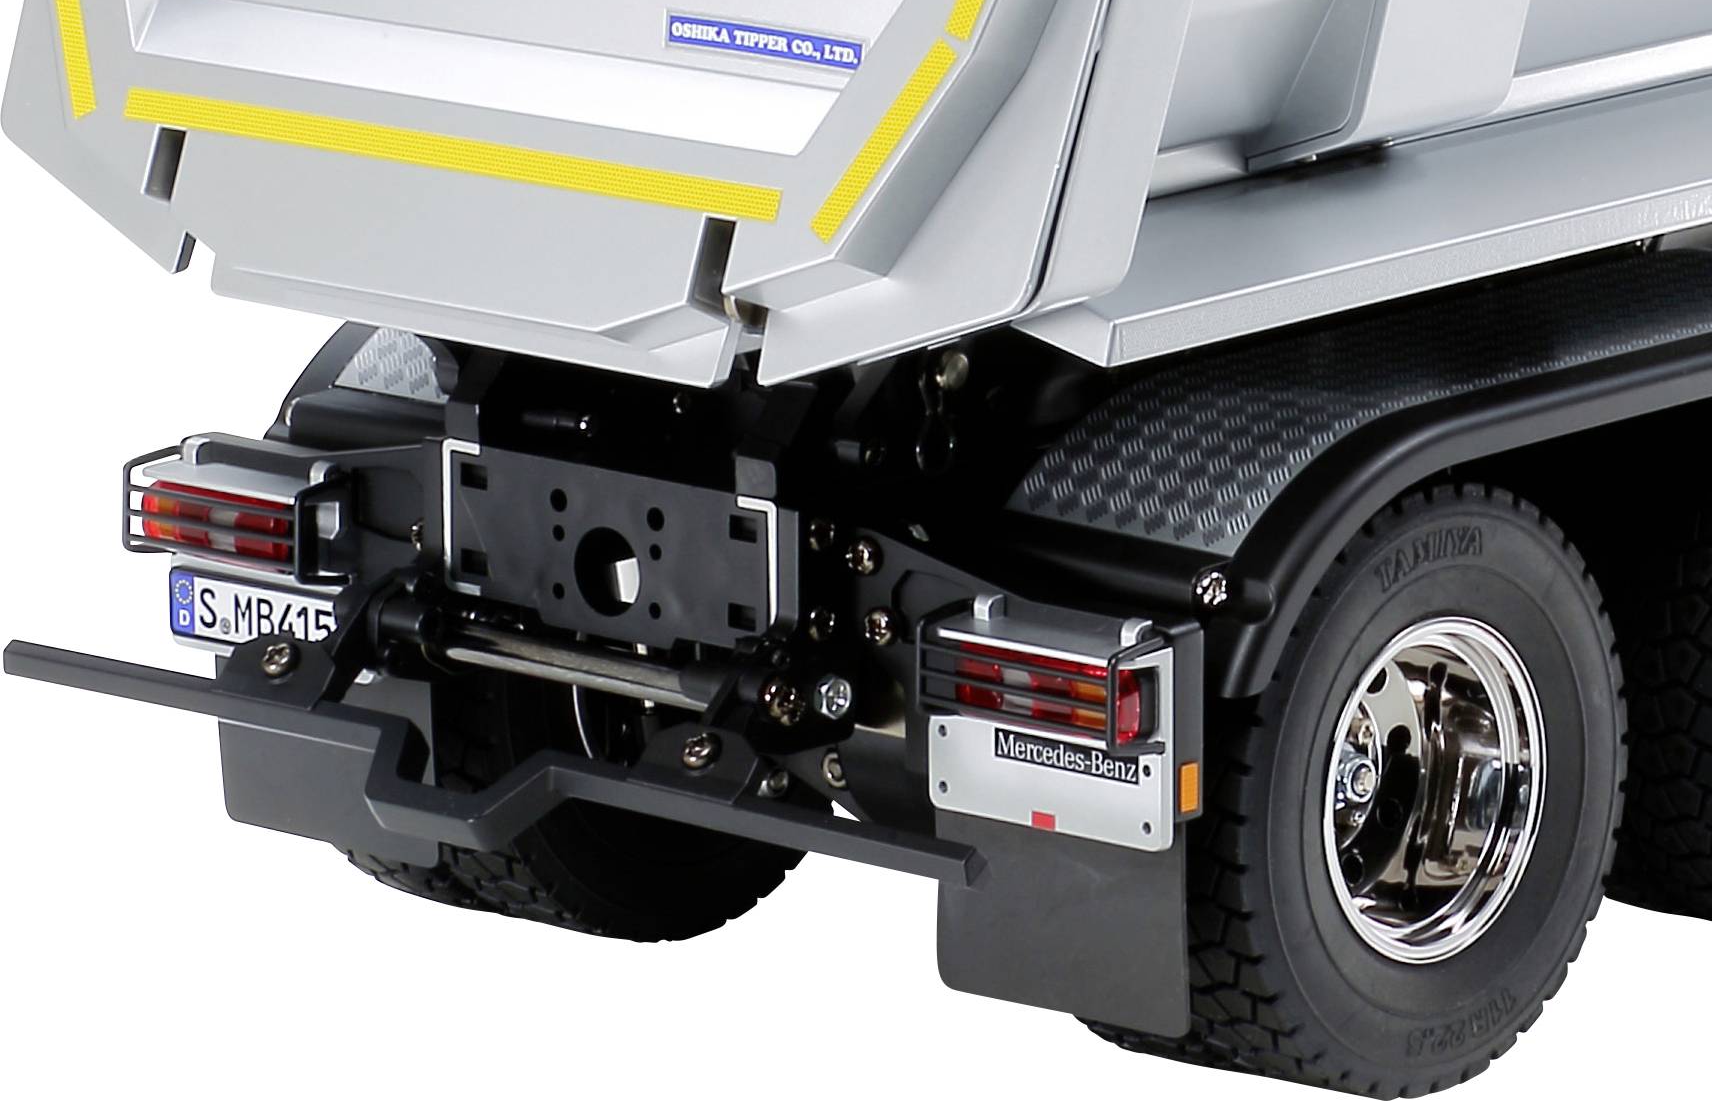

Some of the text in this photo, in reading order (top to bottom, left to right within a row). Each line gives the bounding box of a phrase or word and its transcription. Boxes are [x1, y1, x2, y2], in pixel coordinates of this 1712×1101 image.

[671, 21, 859, 65] OSHIKA TIPPER CO., LTD.
[178, 609, 190, 626] D
[200, 588, 217, 628] S
[997, 731, 1137, 783] Mercedes-Benz
